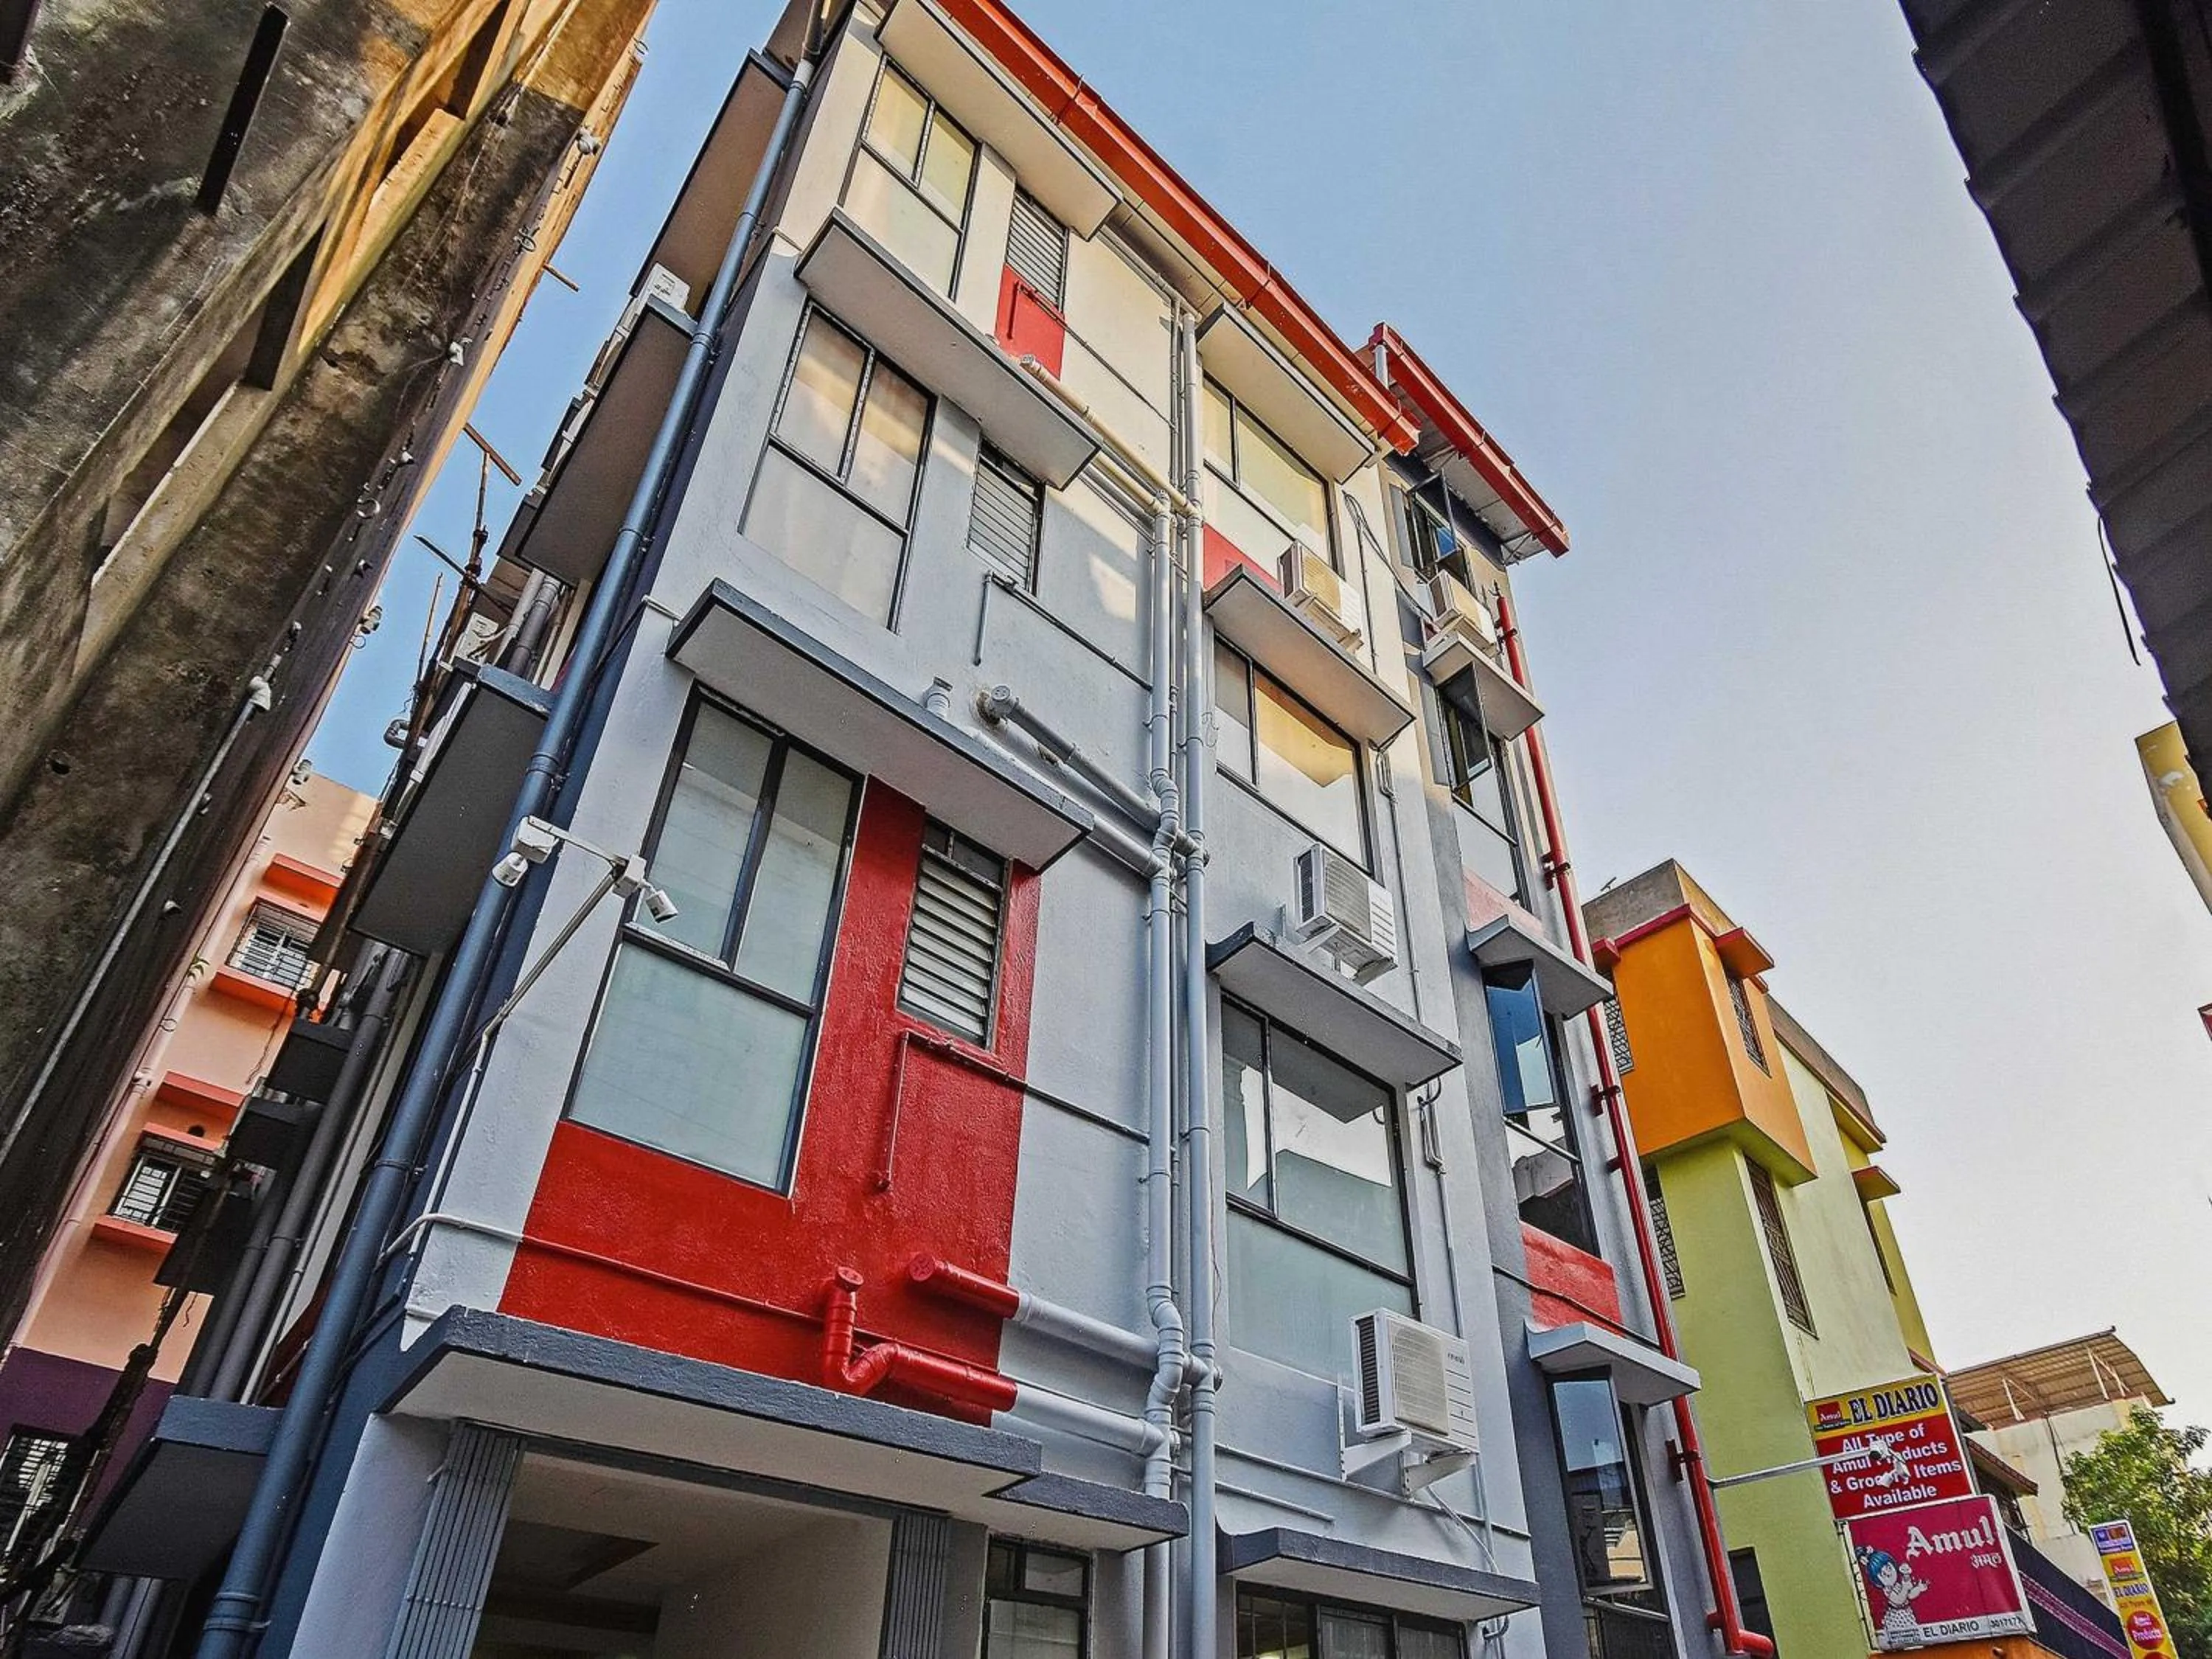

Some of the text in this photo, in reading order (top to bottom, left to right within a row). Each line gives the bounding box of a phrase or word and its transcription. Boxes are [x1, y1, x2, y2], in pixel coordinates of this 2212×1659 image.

[1848, 1382, 1938, 1424] EL DIARIO
[1843, 1436, 1862, 1452] All
[1909, 1423, 1925, 1438] of
[1830, 1480, 1843, 1494] &
[1913, 1459, 1962, 1478] Items
[1832, 1455, 1872, 1474] Amul
[1863, 1484, 1938, 1509] Available
[1907, 1515, 1997, 1561] Amul
[1922, 1626, 1938, 1638] EL
[1939, 1620, 1980, 1635] DIARIO
